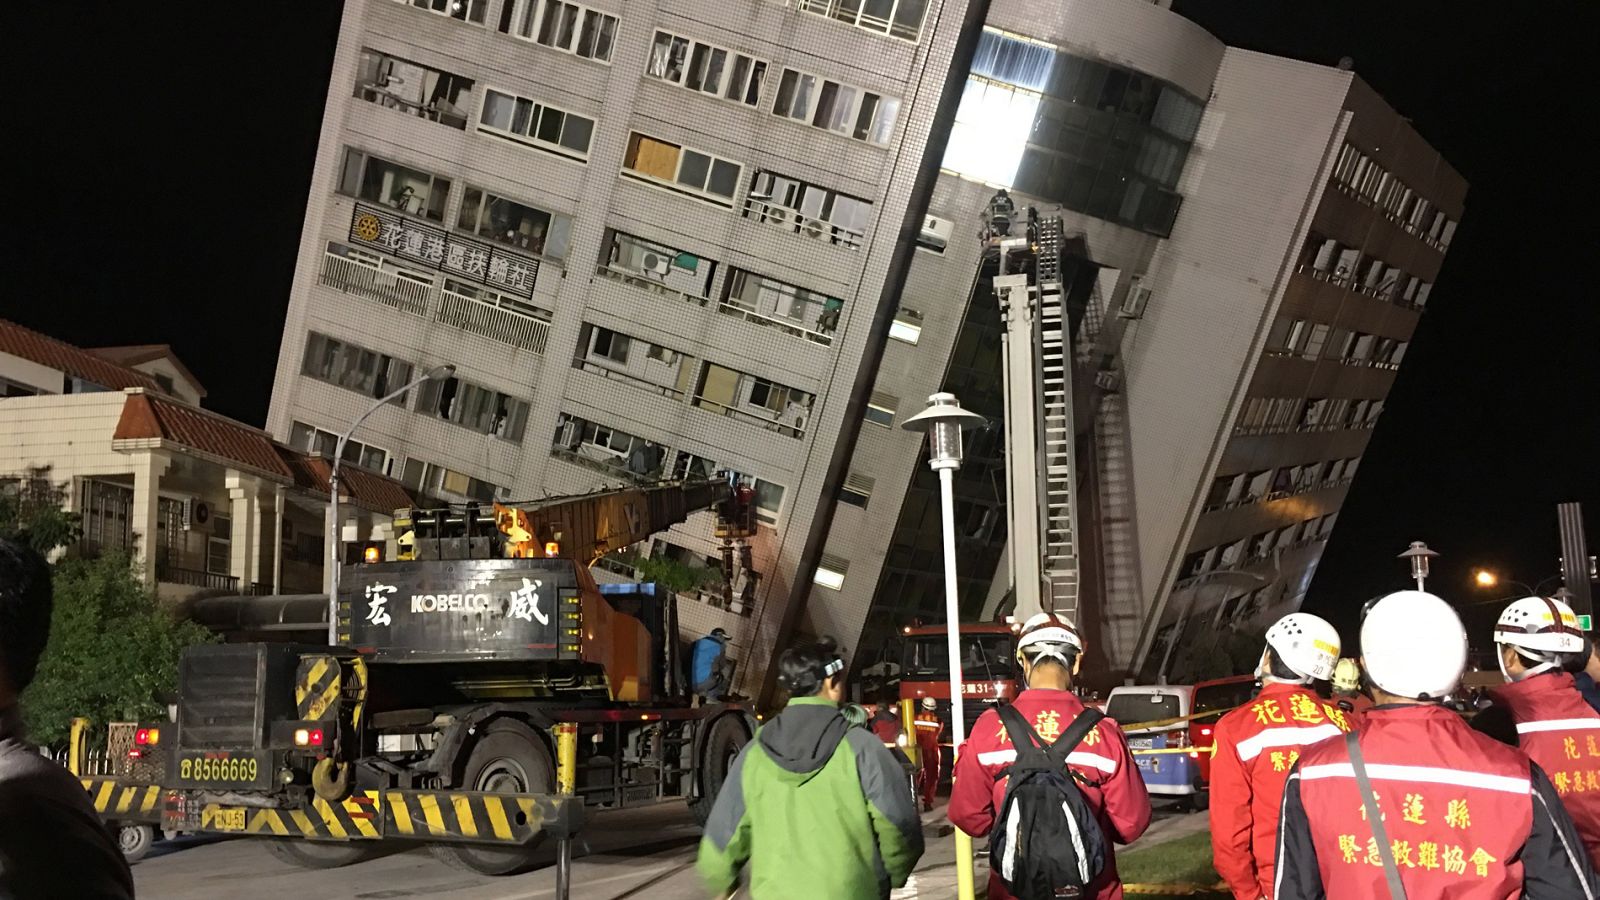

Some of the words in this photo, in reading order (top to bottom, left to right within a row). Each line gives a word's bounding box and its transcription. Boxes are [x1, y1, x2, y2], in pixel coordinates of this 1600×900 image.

[382, 223, 530, 291] 花蓮港區扶輪社
[365, 581, 398, 626] 宏
[411, 593, 489, 613] KOBELCO
[507, 577, 549, 625] 威
[1560, 638, 1571, 648] 34
[1312, 664, 1324, 675] 20
[193, 757, 257, 781] 8566669
[1338, 834, 1497, 877] 緊急救難協會
